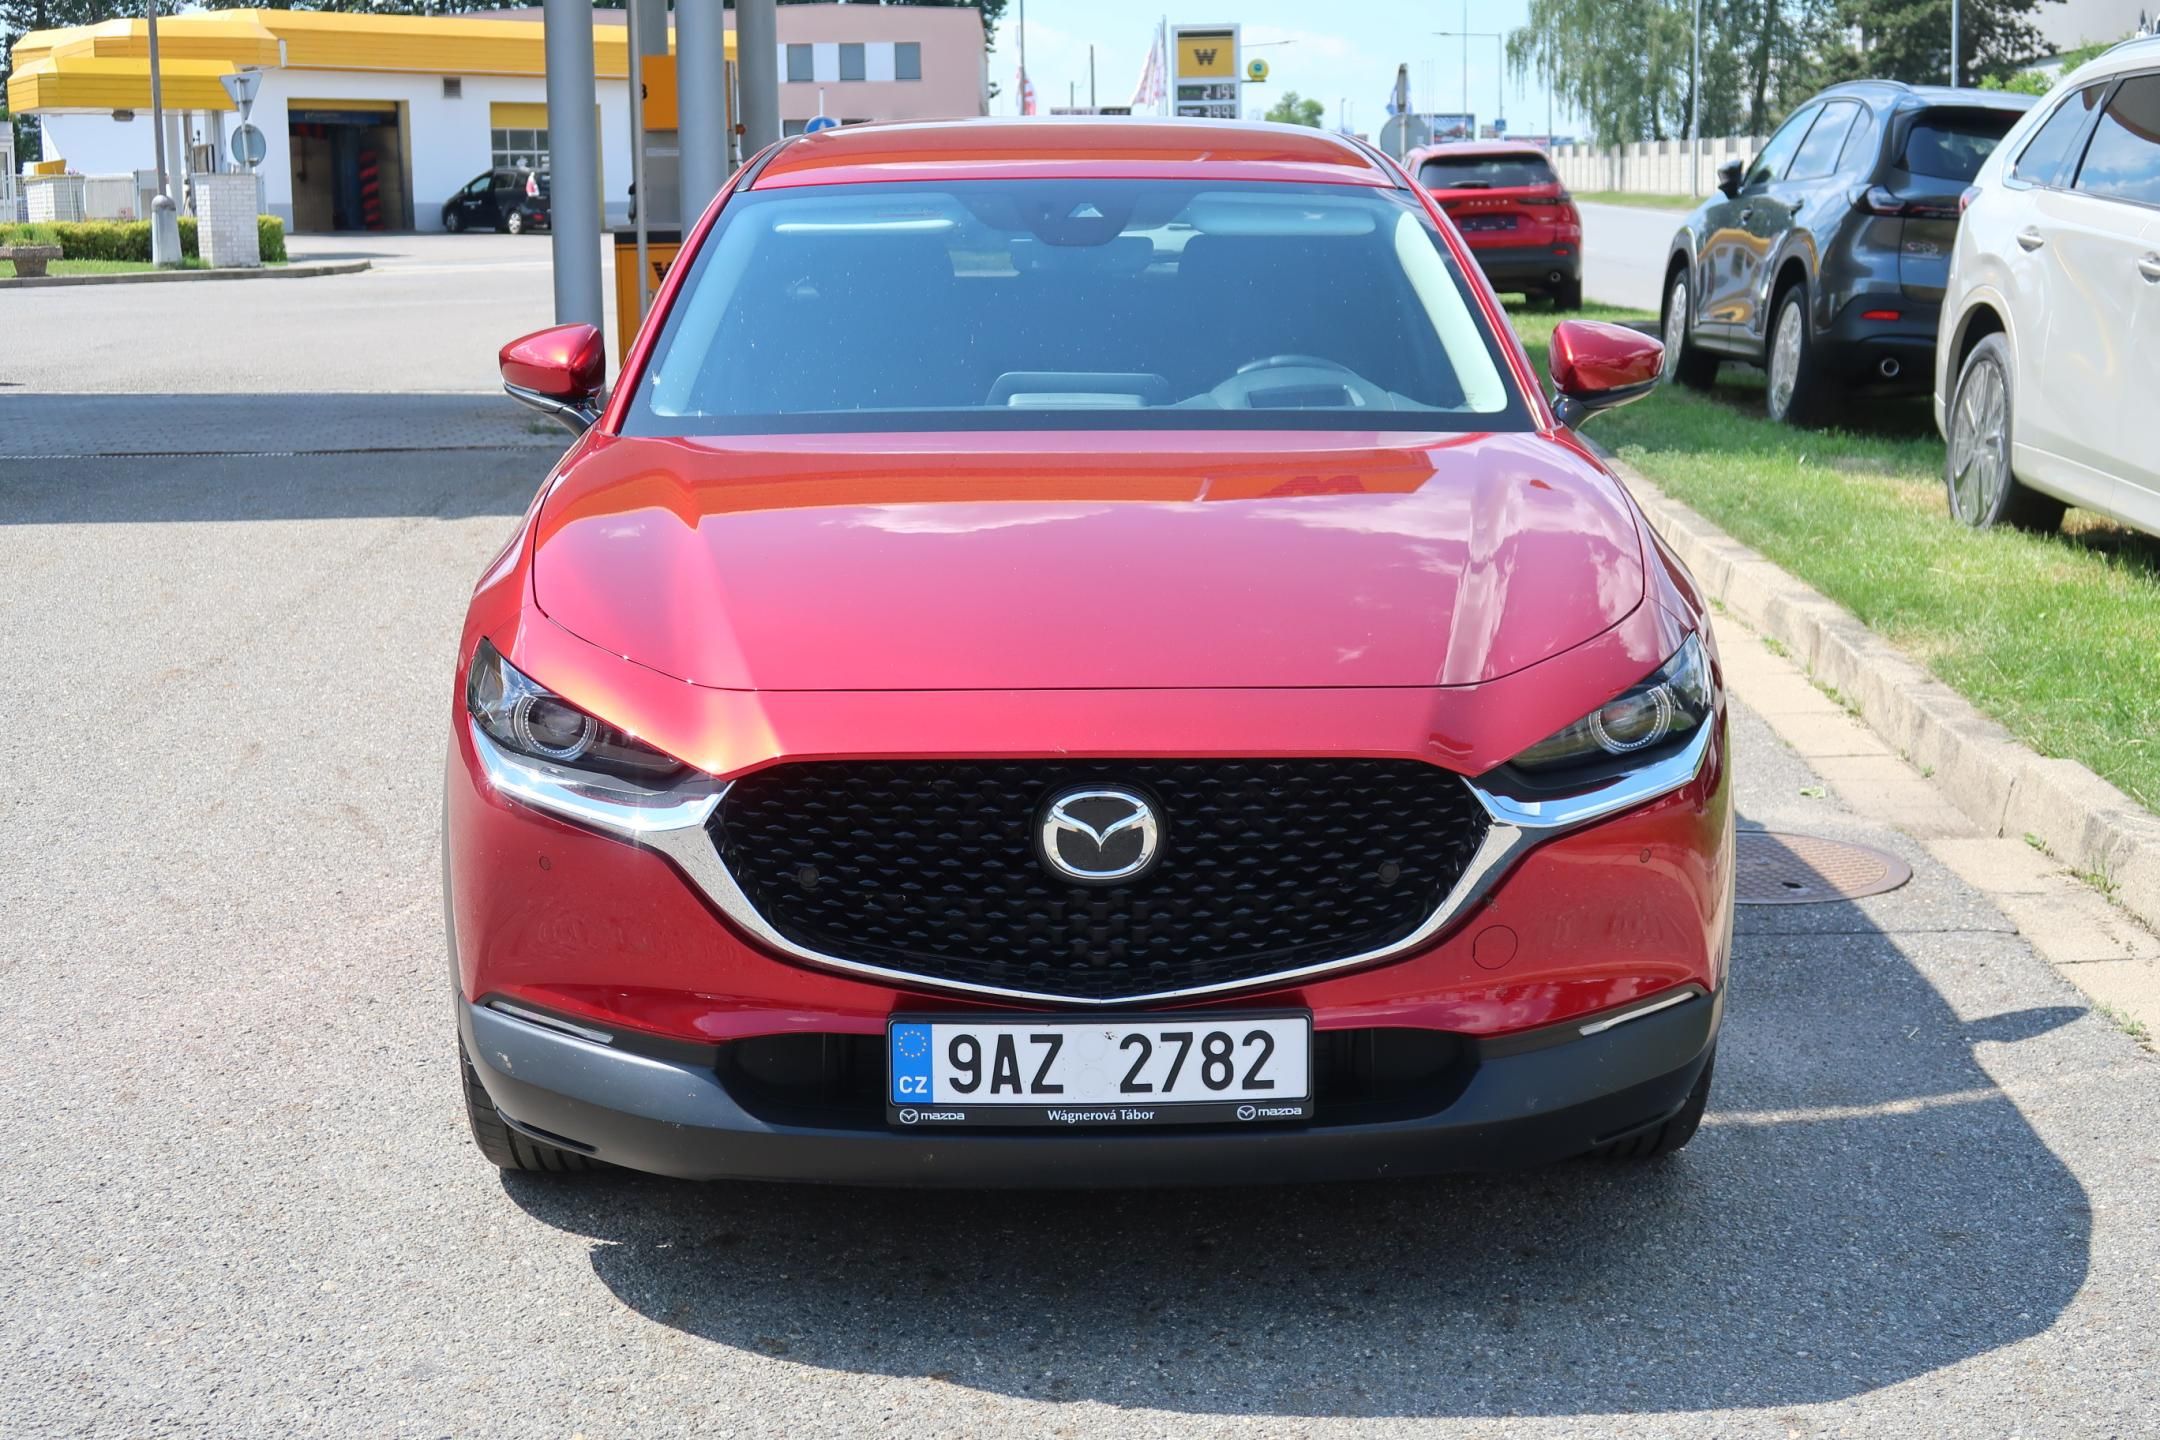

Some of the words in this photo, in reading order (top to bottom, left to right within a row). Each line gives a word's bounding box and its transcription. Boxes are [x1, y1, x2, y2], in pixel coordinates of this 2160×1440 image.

[1193, 47, 1218, 66] W
[948, 1033, 1064, 1095] 9AZ
[1119, 1029, 1275, 1094] 2782
[899, 1076, 928, 1094] CZ
[920, 1111, 966, 1121] mazda
[1047, 1109, 1117, 1124] Wágnerová
[1120, 1108, 1156, 1121] Tábor
[1257, 1106, 1303, 1117] mazda
